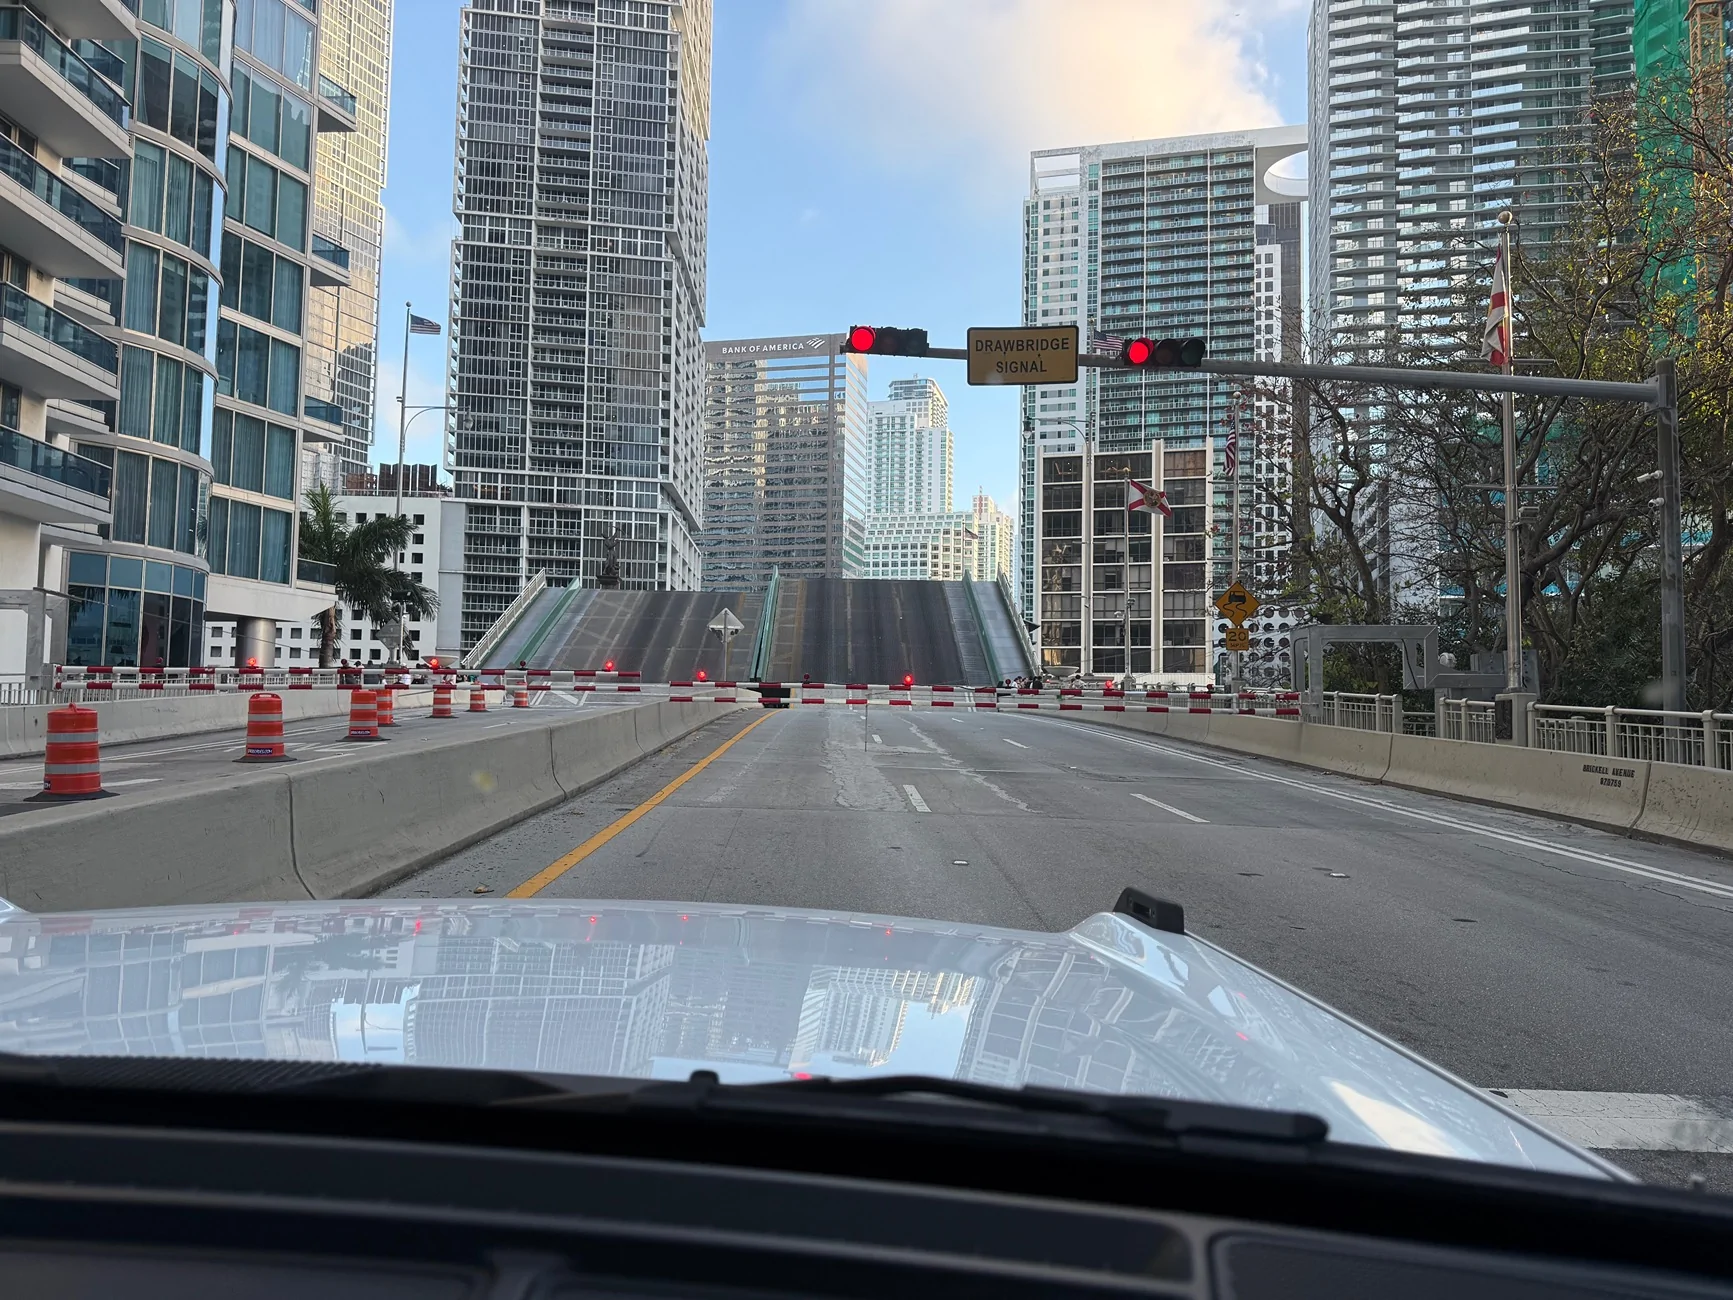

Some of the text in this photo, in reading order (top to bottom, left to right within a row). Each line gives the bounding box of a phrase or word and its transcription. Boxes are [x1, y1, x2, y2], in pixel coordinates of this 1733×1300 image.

[722, 342, 804, 354] BANK OF AMERICA
[975, 338, 1069, 352] DRAWBRIDGE
[996, 360, 1047, 373] SIGNAL
[1228, 631, 1246, 641] 20
[1583, 764, 1635, 778] BRICKELL AVENUE
